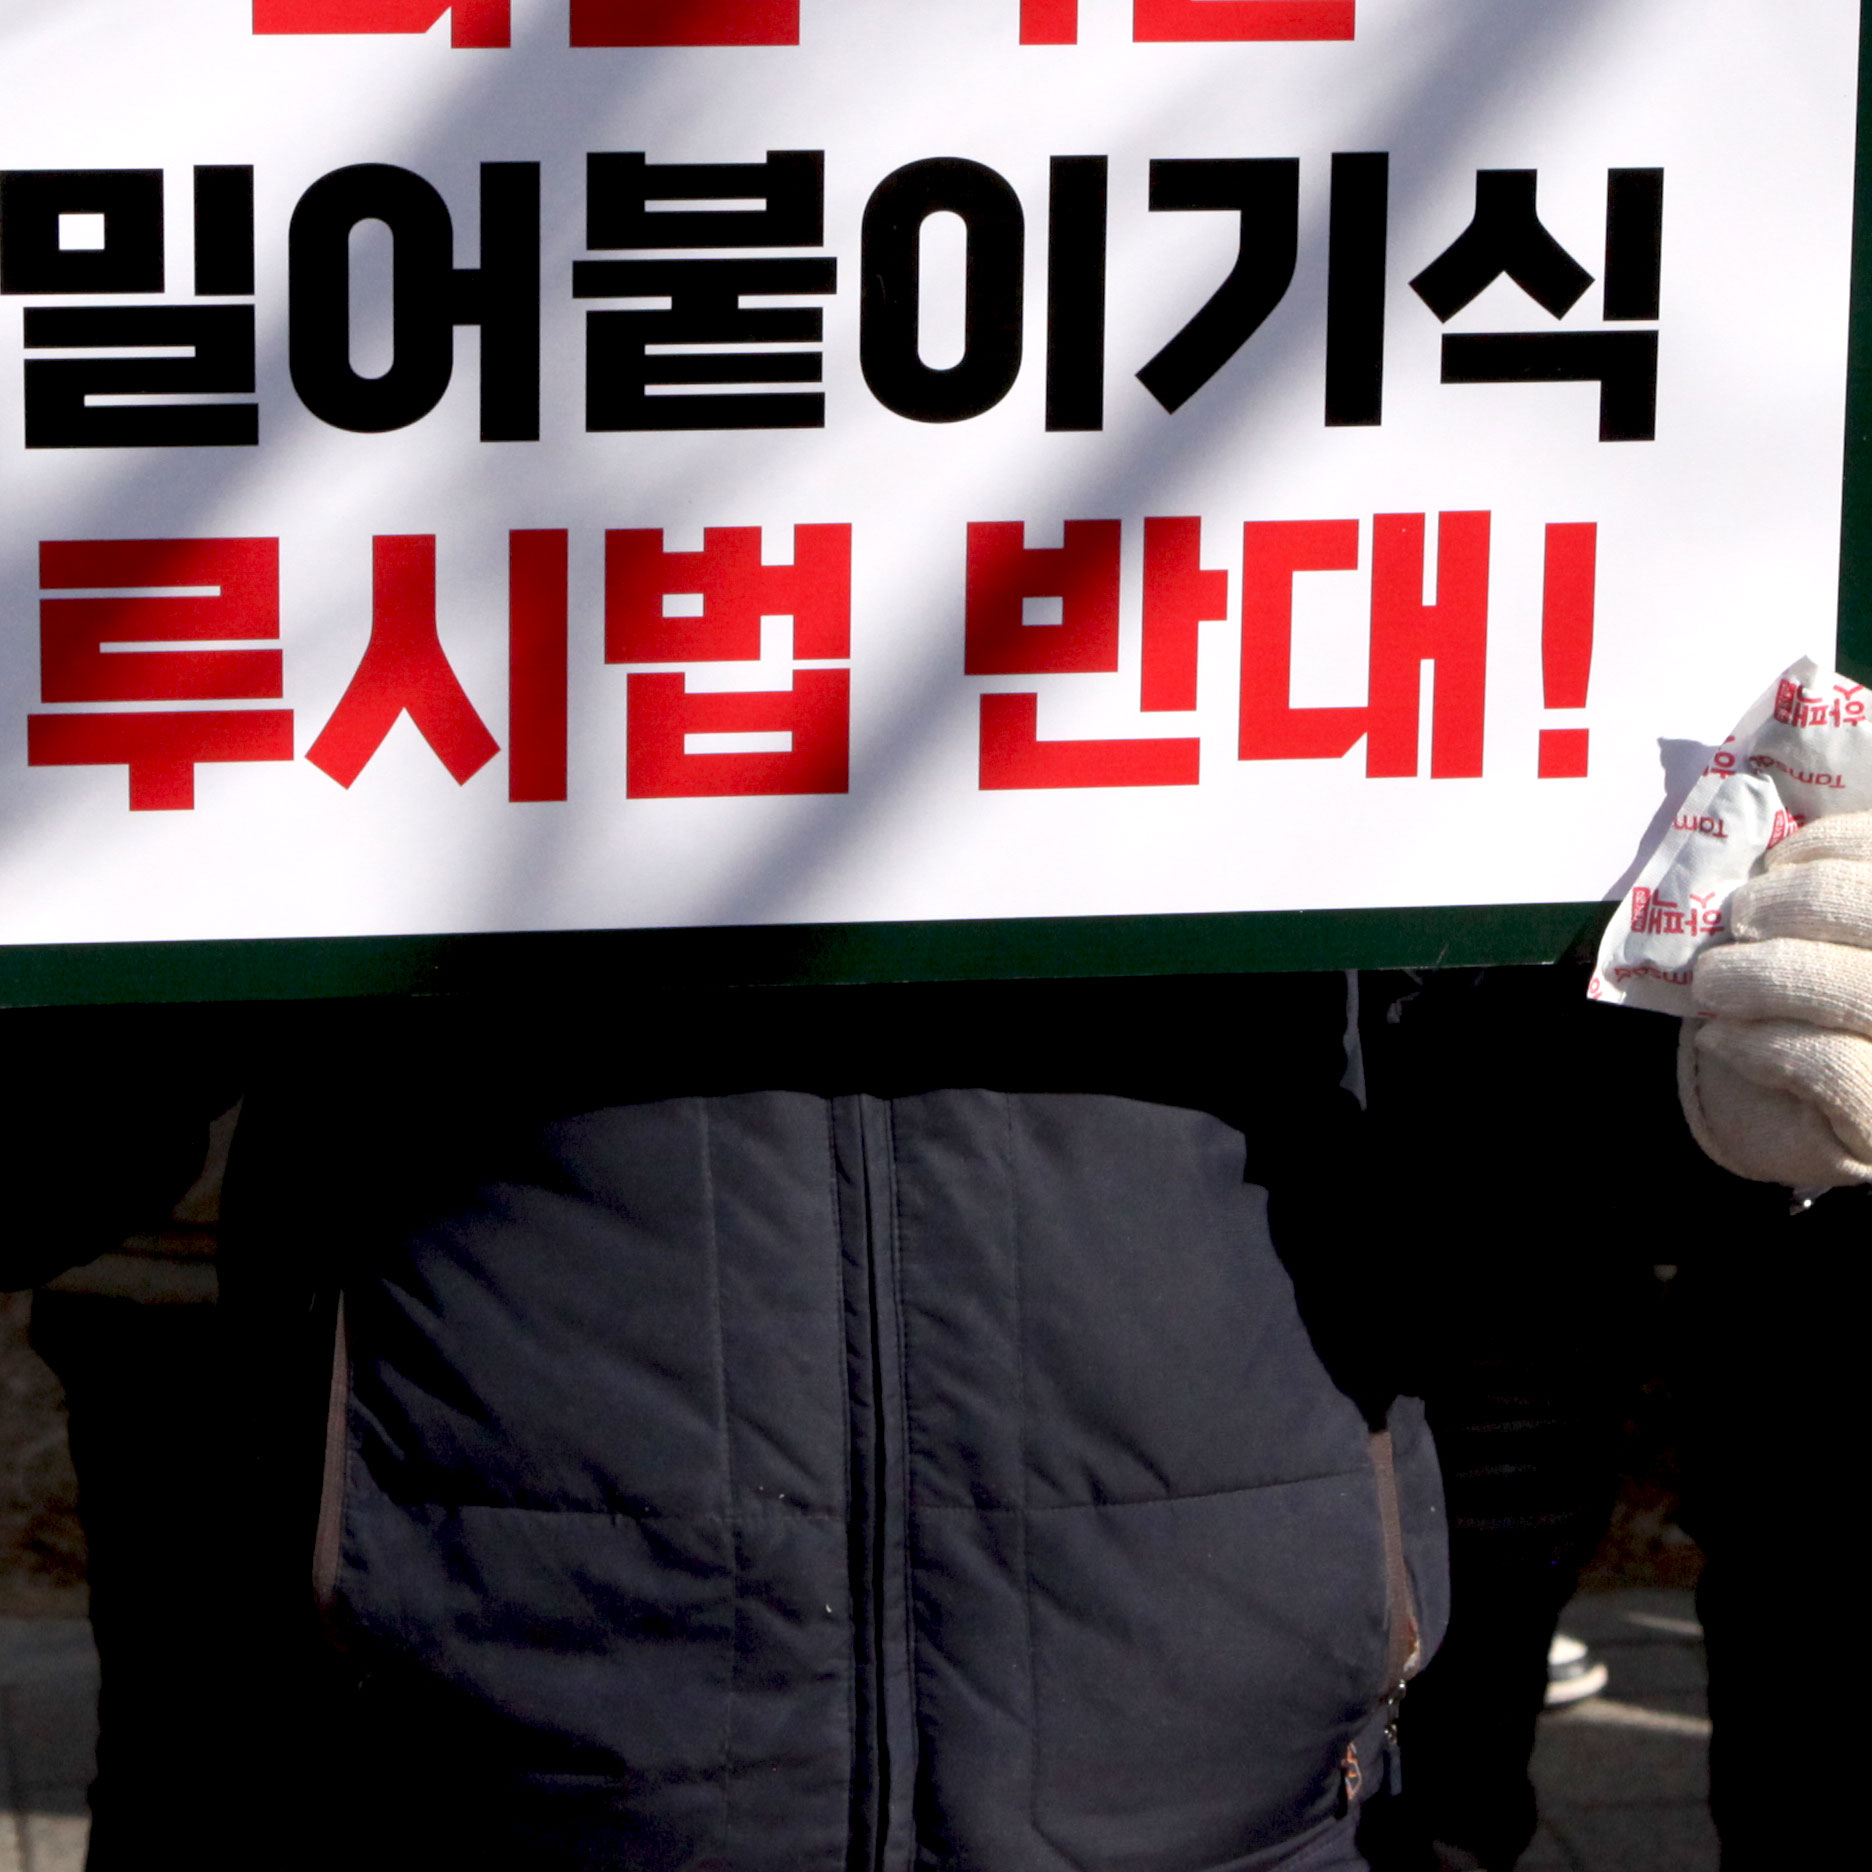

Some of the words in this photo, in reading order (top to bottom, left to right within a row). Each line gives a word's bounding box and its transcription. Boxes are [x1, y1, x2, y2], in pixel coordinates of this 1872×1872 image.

[28, 523, 853, 812] 루시법
[964, 510, 1598, 791] 반대!
[1648, 889, 1726, 937] 핫팩
